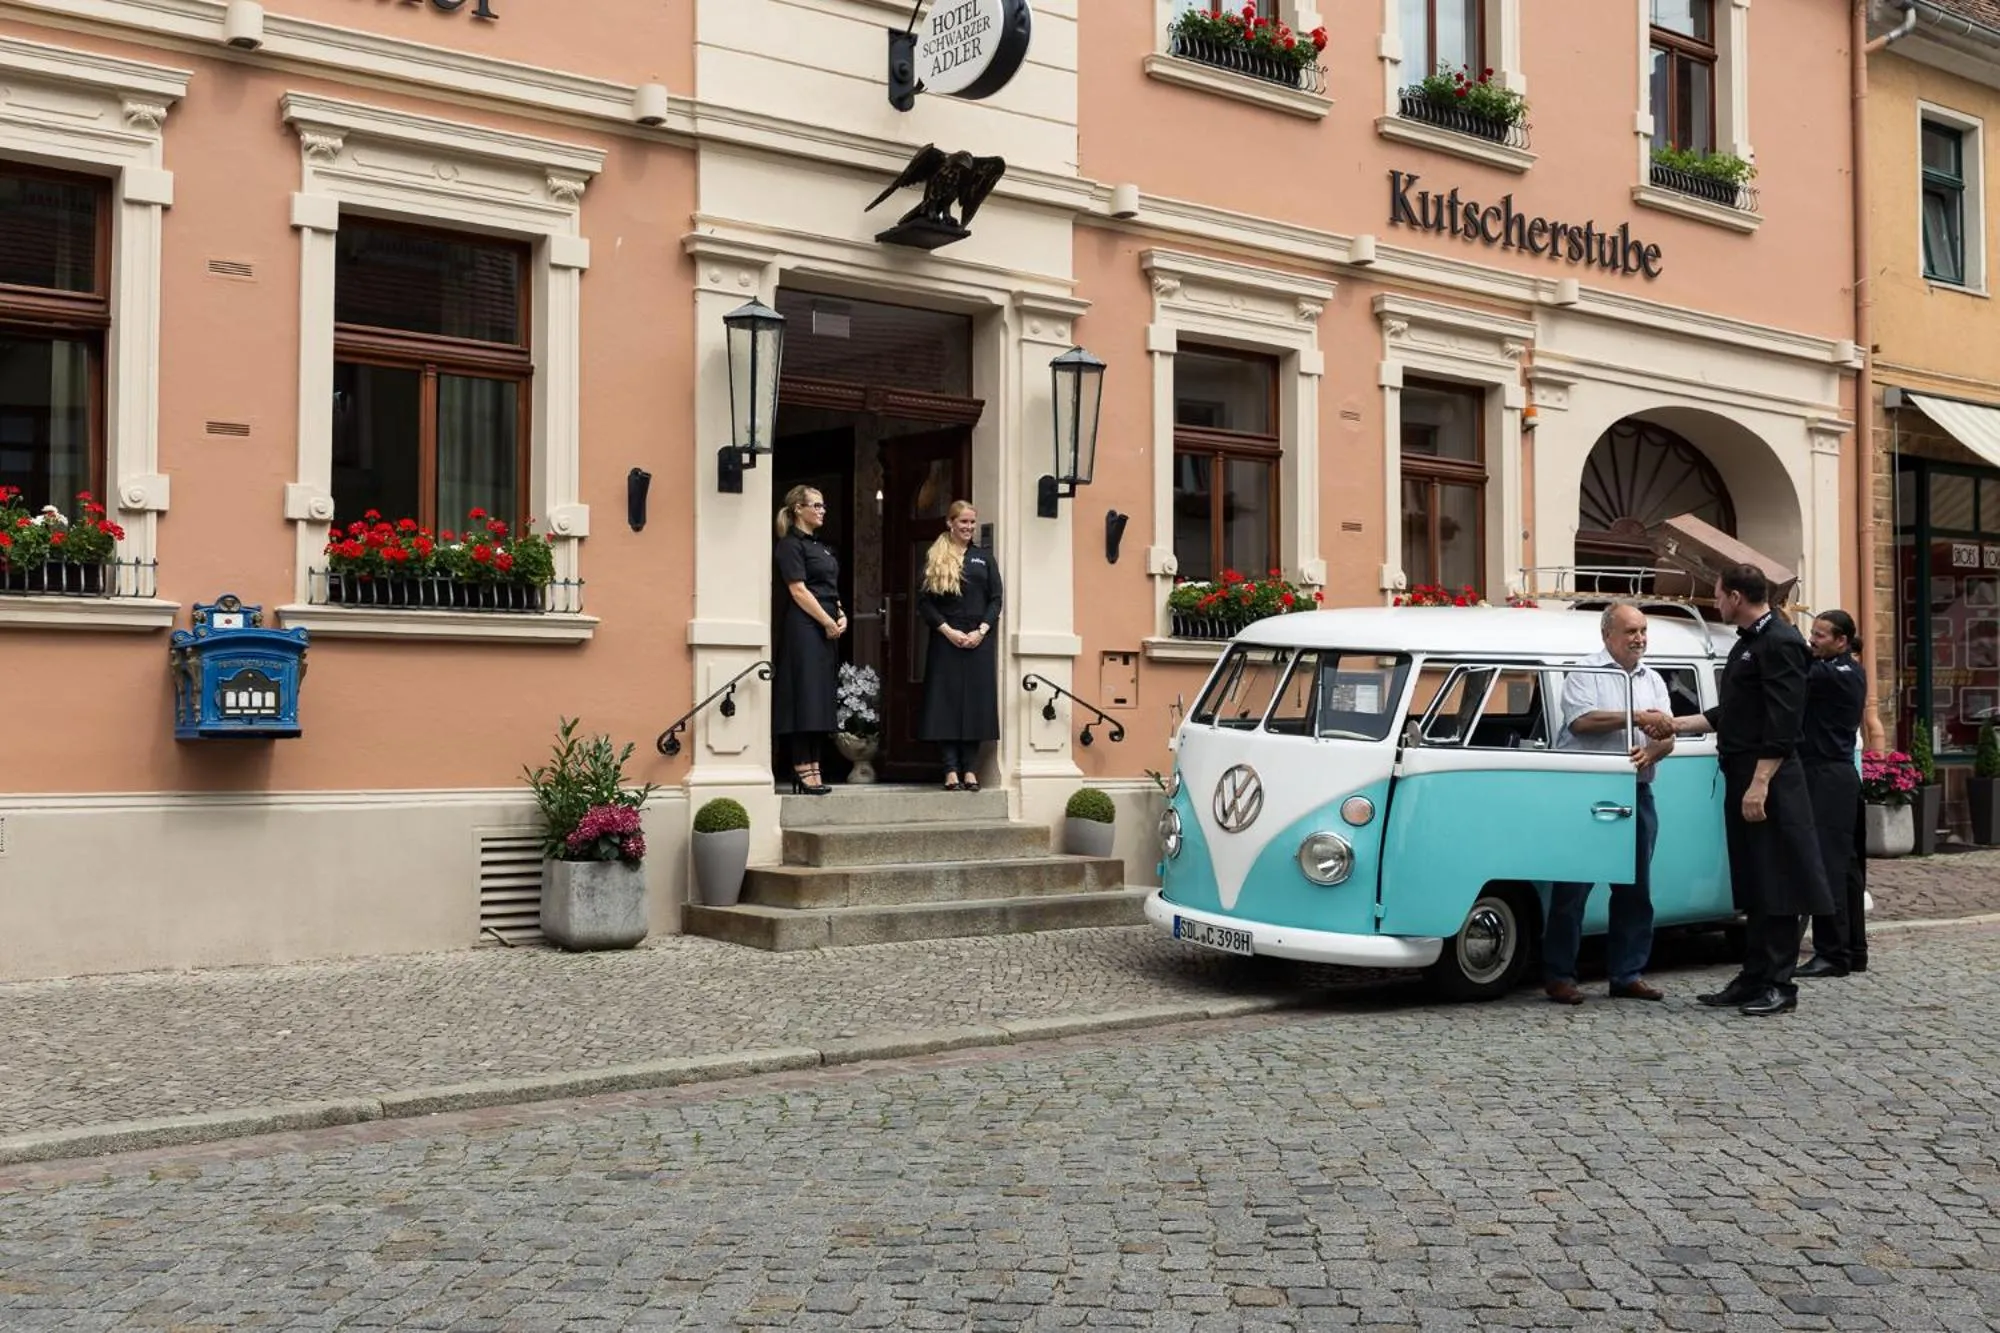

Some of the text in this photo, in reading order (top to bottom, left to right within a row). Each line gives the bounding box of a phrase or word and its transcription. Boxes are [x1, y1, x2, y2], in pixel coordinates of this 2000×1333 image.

[922, 15, 991, 58] SCHWARZER
[932, 0, 981, 36] HOTEL
[931, 37, 983, 77] ADLER
[1387, 169, 1664, 279] Kutscherstube
[1180, 919, 1250, 953] SDL C 398H
